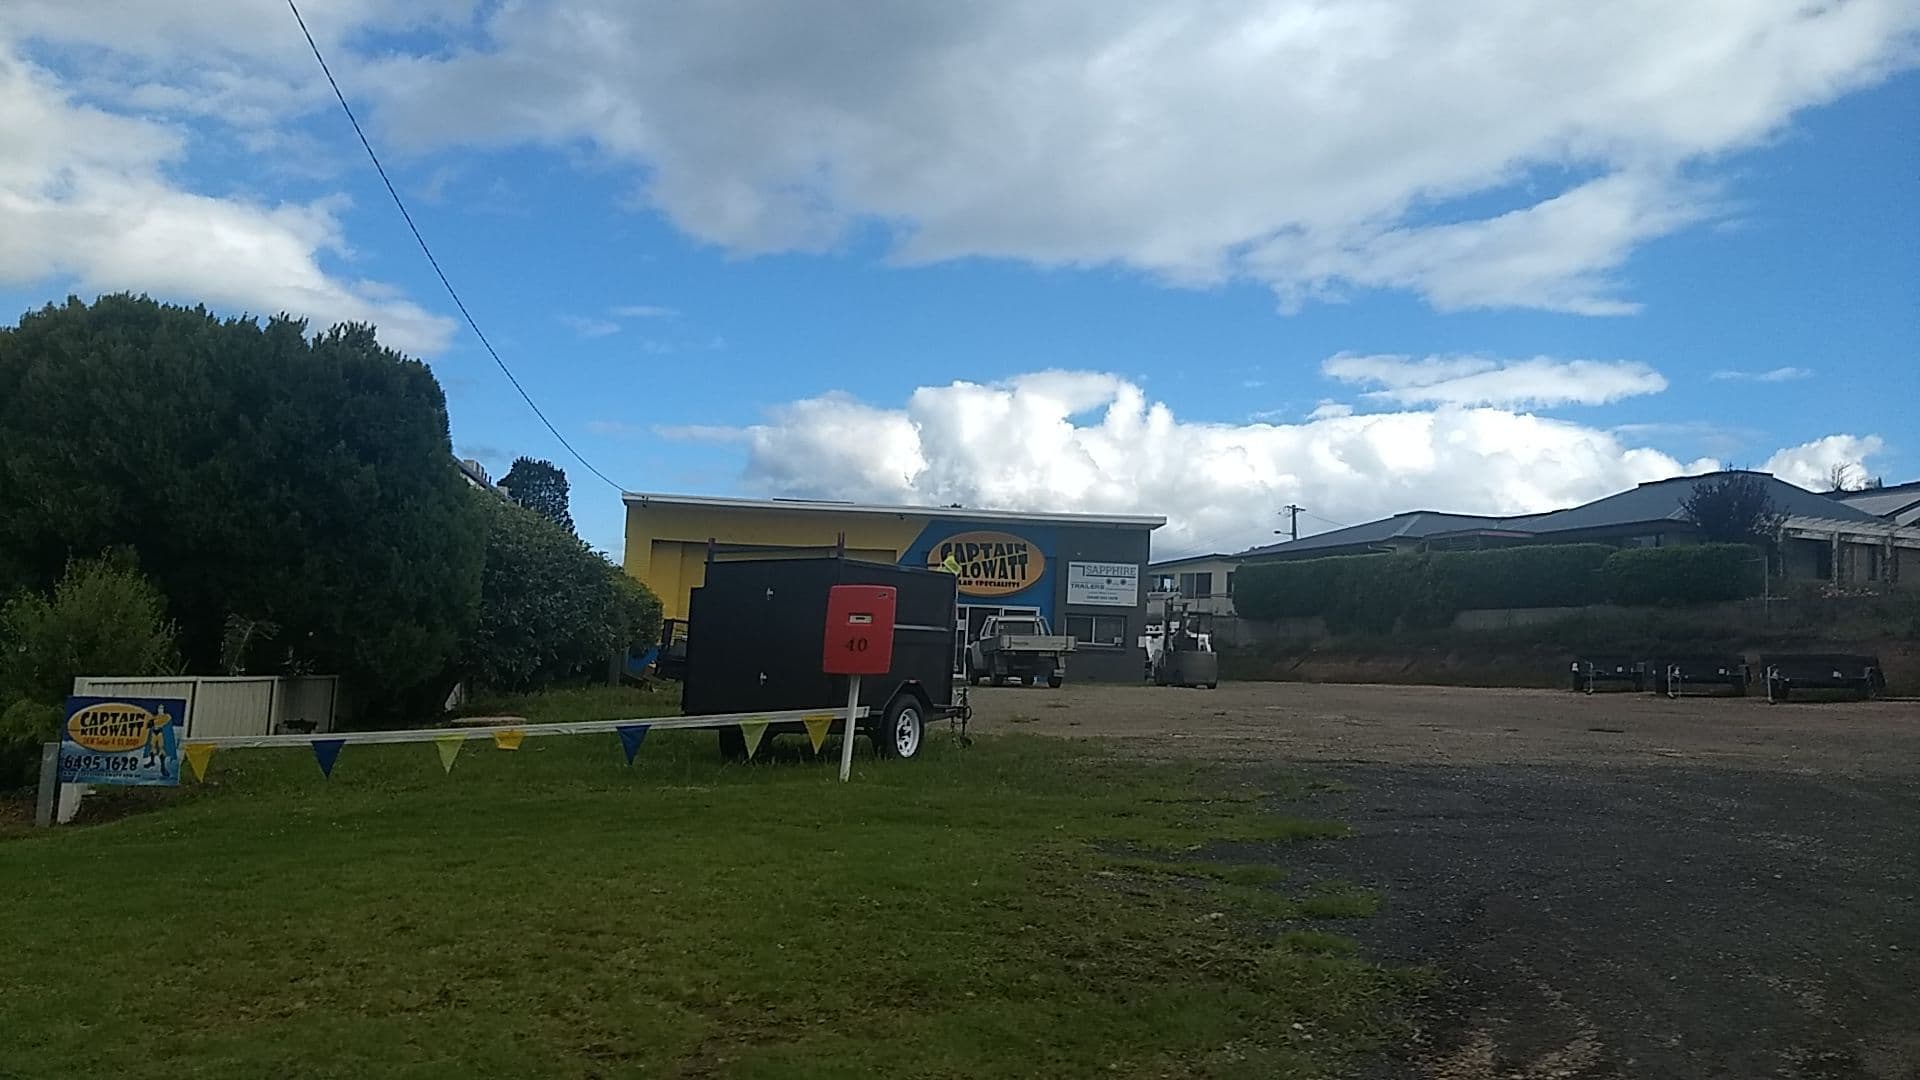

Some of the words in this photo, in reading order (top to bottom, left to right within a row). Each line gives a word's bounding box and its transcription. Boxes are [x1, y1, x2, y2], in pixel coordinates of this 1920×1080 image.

[941, 543, 1027, 563] CAPTAIN
[958, 554, 1028, 580] LOWATT
[1086, 565, 1136, 576] SAPPHIRE
[846, 637, 868, 652] 40
[80, 712, 146, 727] CAPTAIN
[80, 721, 145, 737] KILOWATT
[64, 755, 100, 770] 6495
[105, 756, 139, 771] 1628
